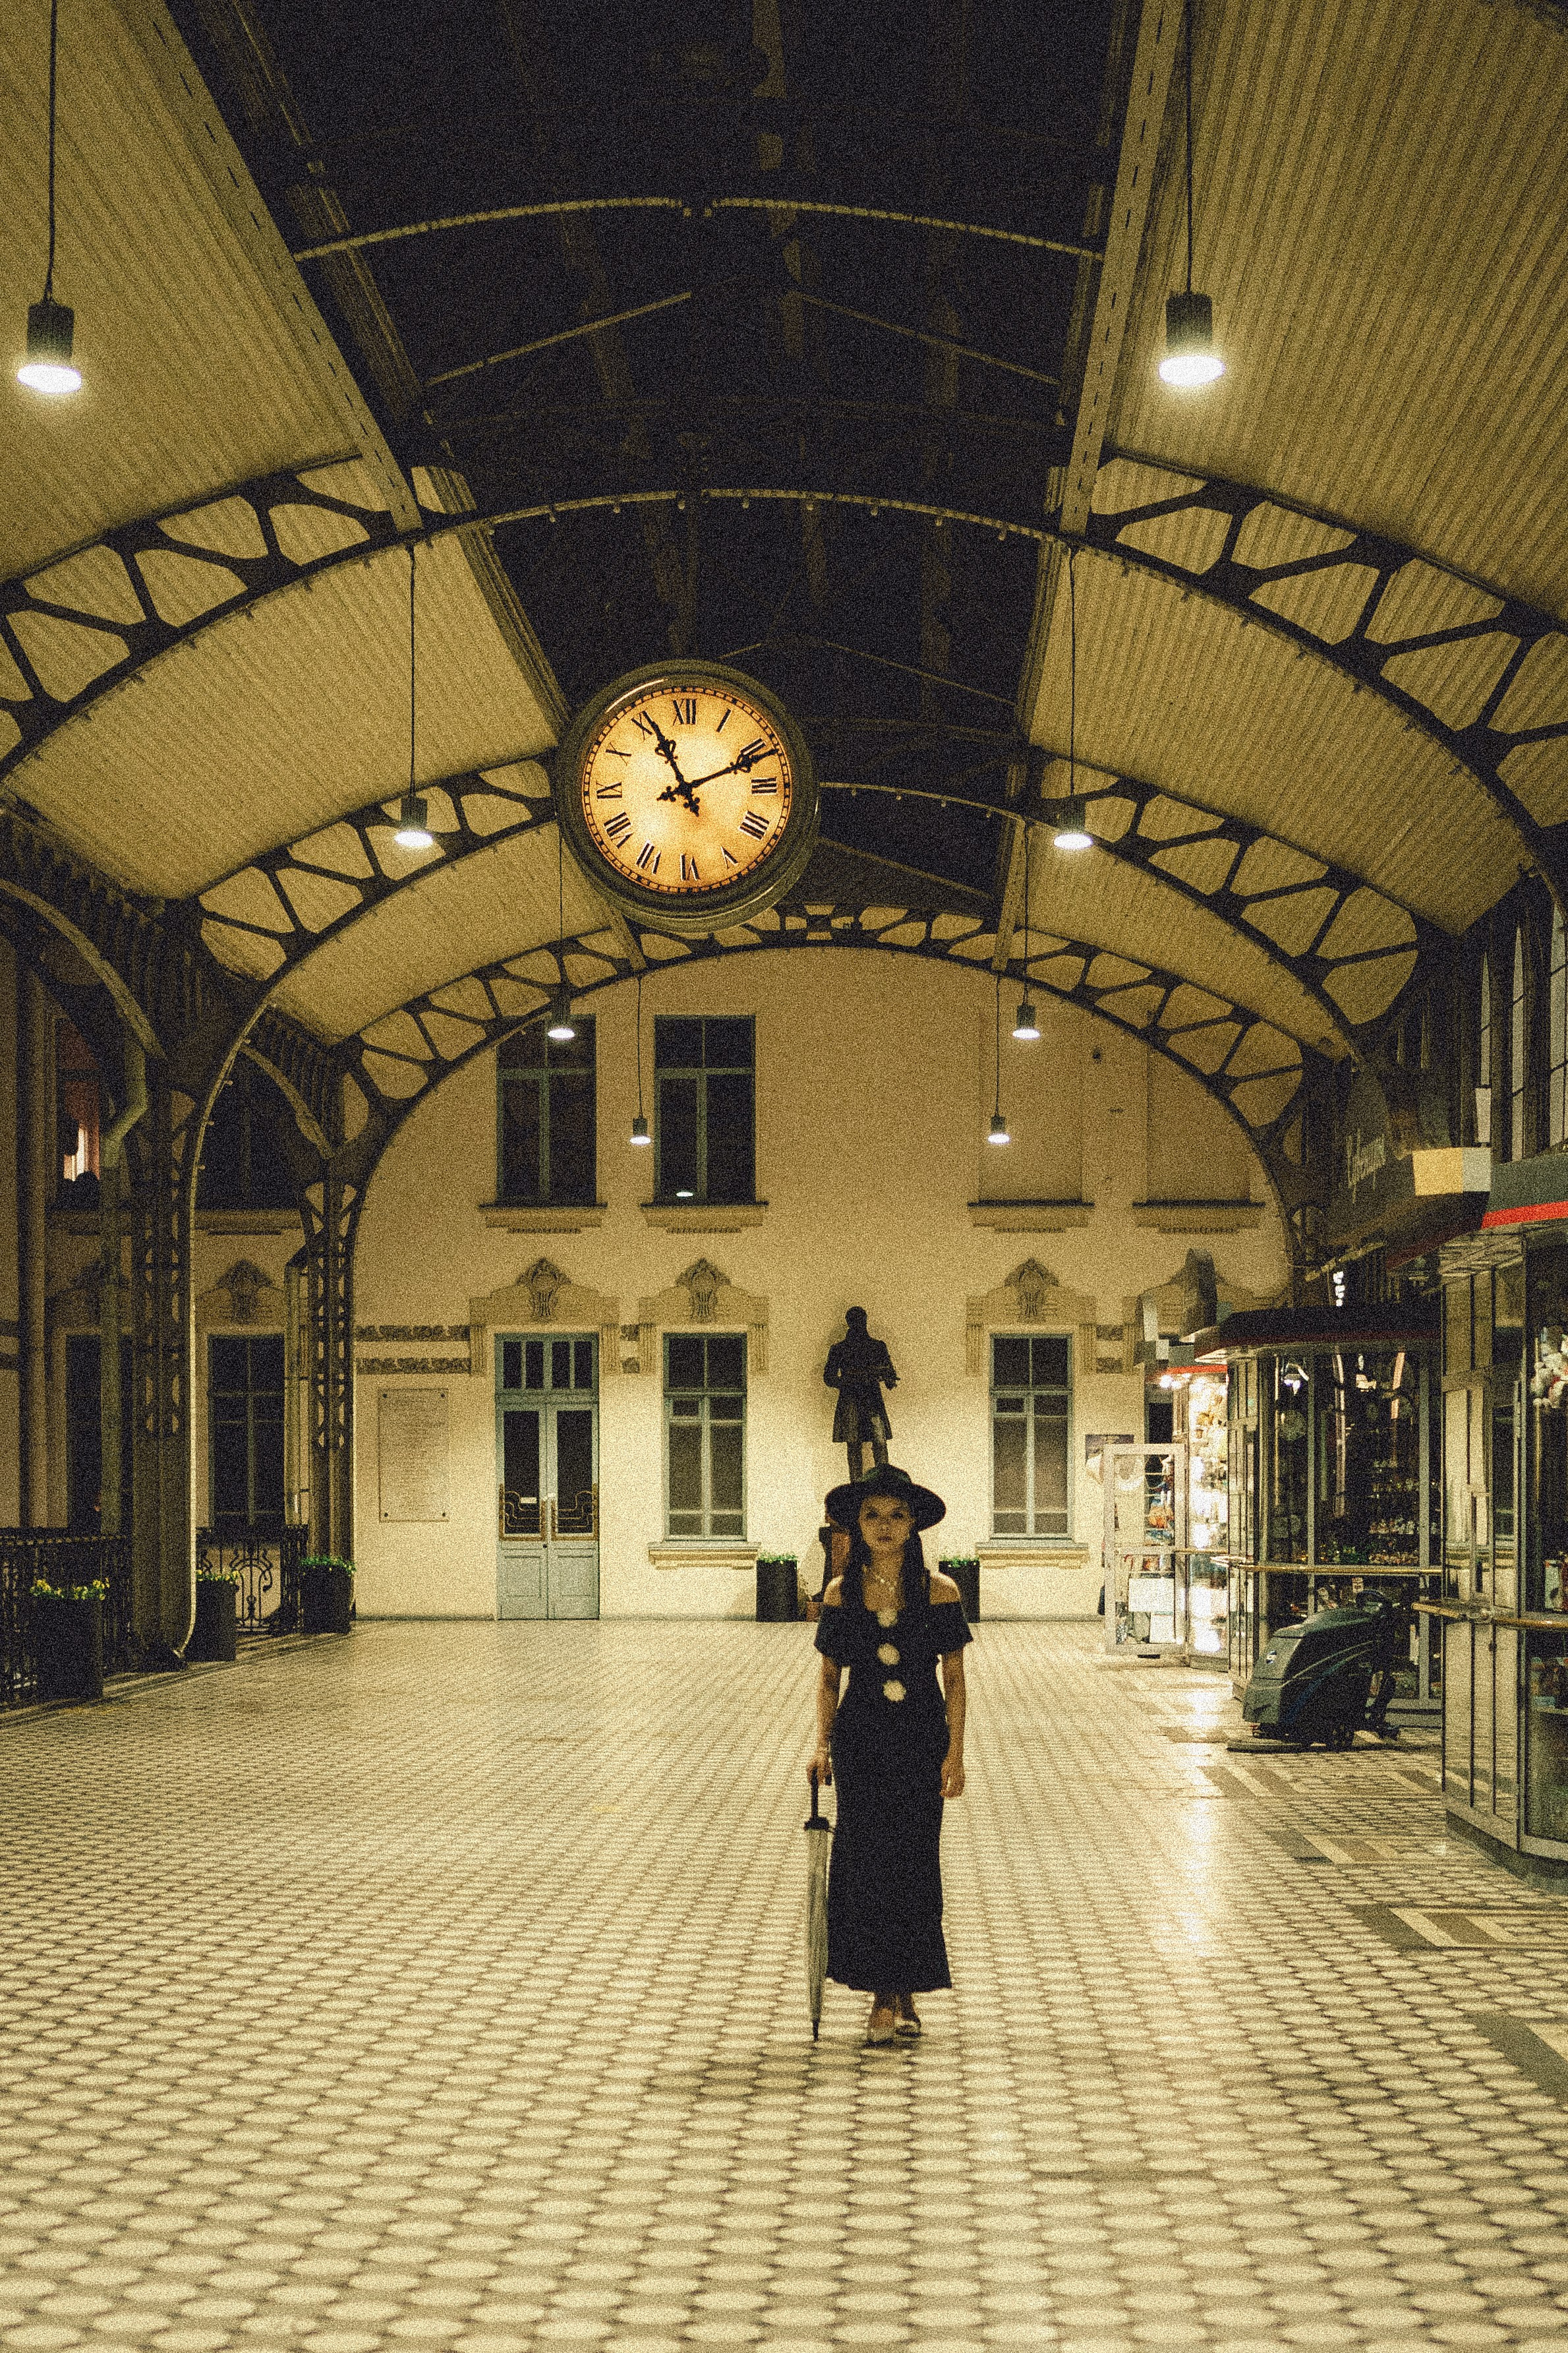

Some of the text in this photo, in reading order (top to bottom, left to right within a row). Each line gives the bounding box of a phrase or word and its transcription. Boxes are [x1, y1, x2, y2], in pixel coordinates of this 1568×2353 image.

[672, 699, 697, 725] XII
[716, 709, 732, 732] I
[605, 742, 631, 766] X
[596, 781, 623, 800] IX
[751, 777, 778, 795] III
[603, 811, 634, 849] VIII
[740, 810, 770, 841] IIII
[635, 843, 662, 875] VII
[680, 854, 701, 881] VI
[721, 846, 739, 870] V
